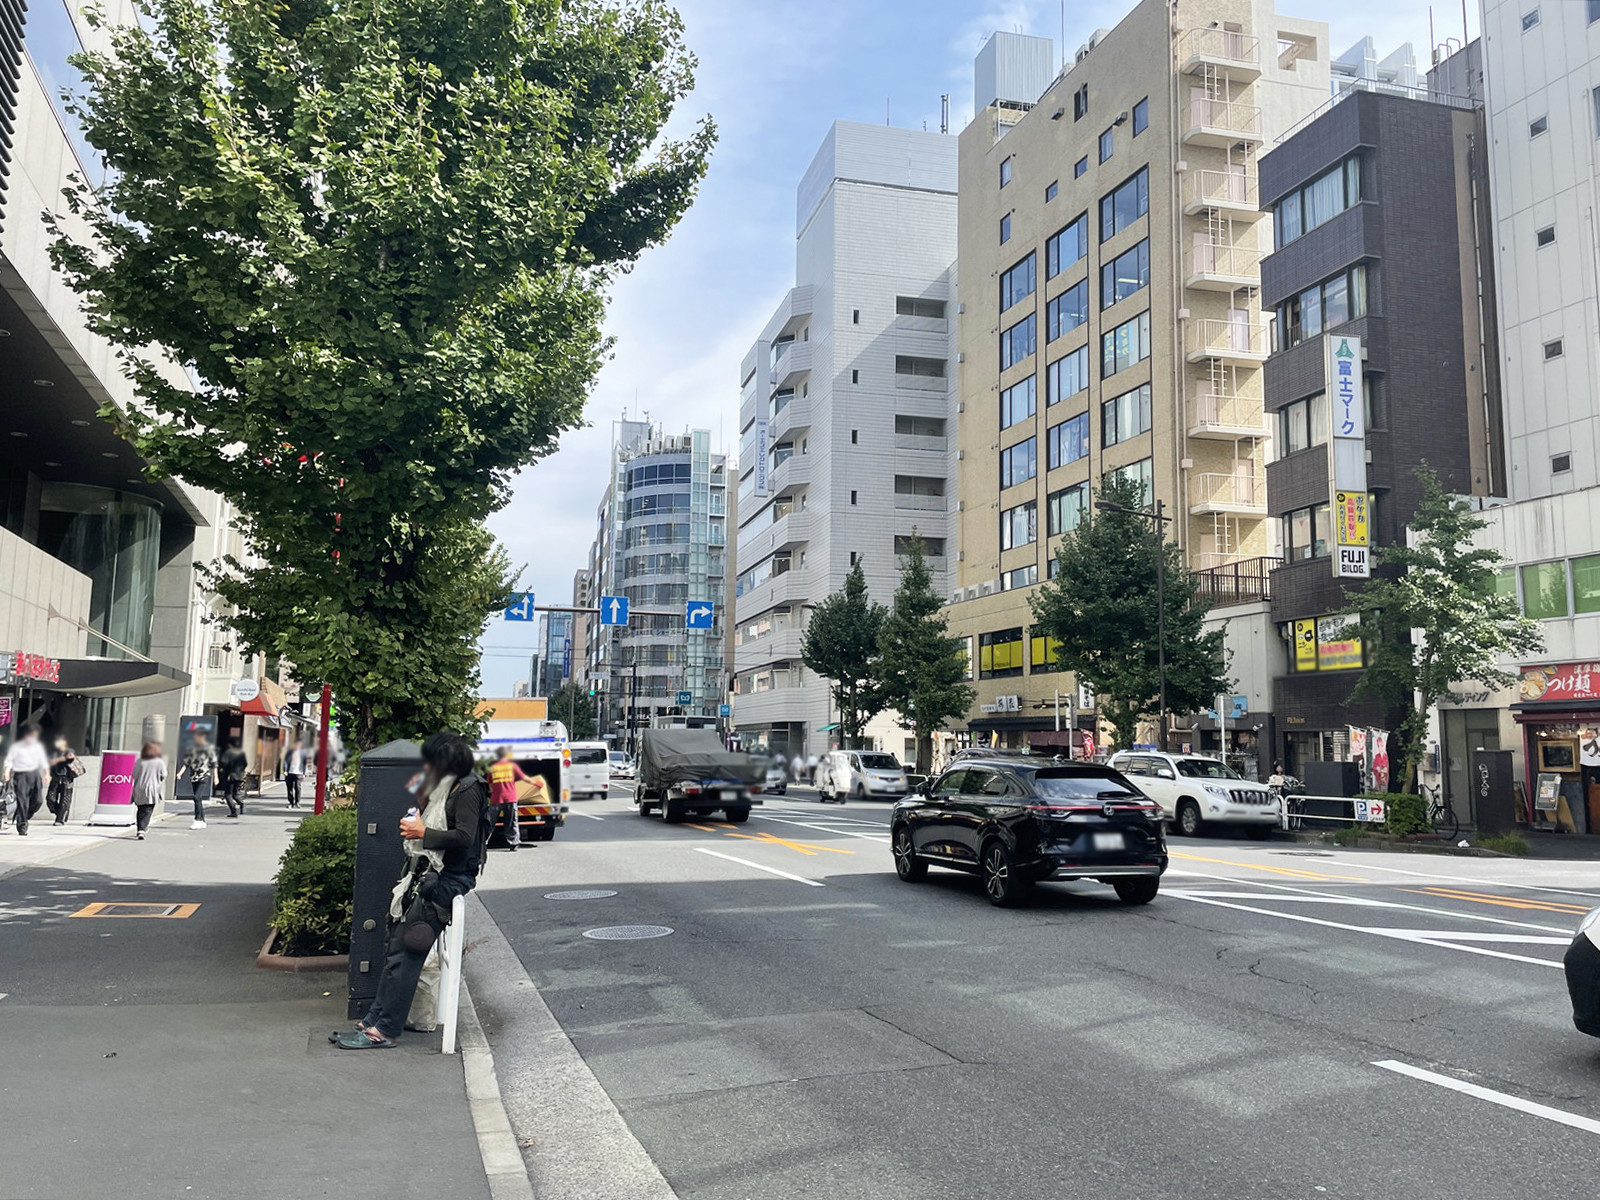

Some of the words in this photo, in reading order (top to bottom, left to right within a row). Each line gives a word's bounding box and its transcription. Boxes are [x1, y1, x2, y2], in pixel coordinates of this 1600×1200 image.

[1338, 360, 1354, 434] 富士マーク
[1341, 550, 1365, 563] FUJI
[1547, 674, 1591, 693] つけ麺
